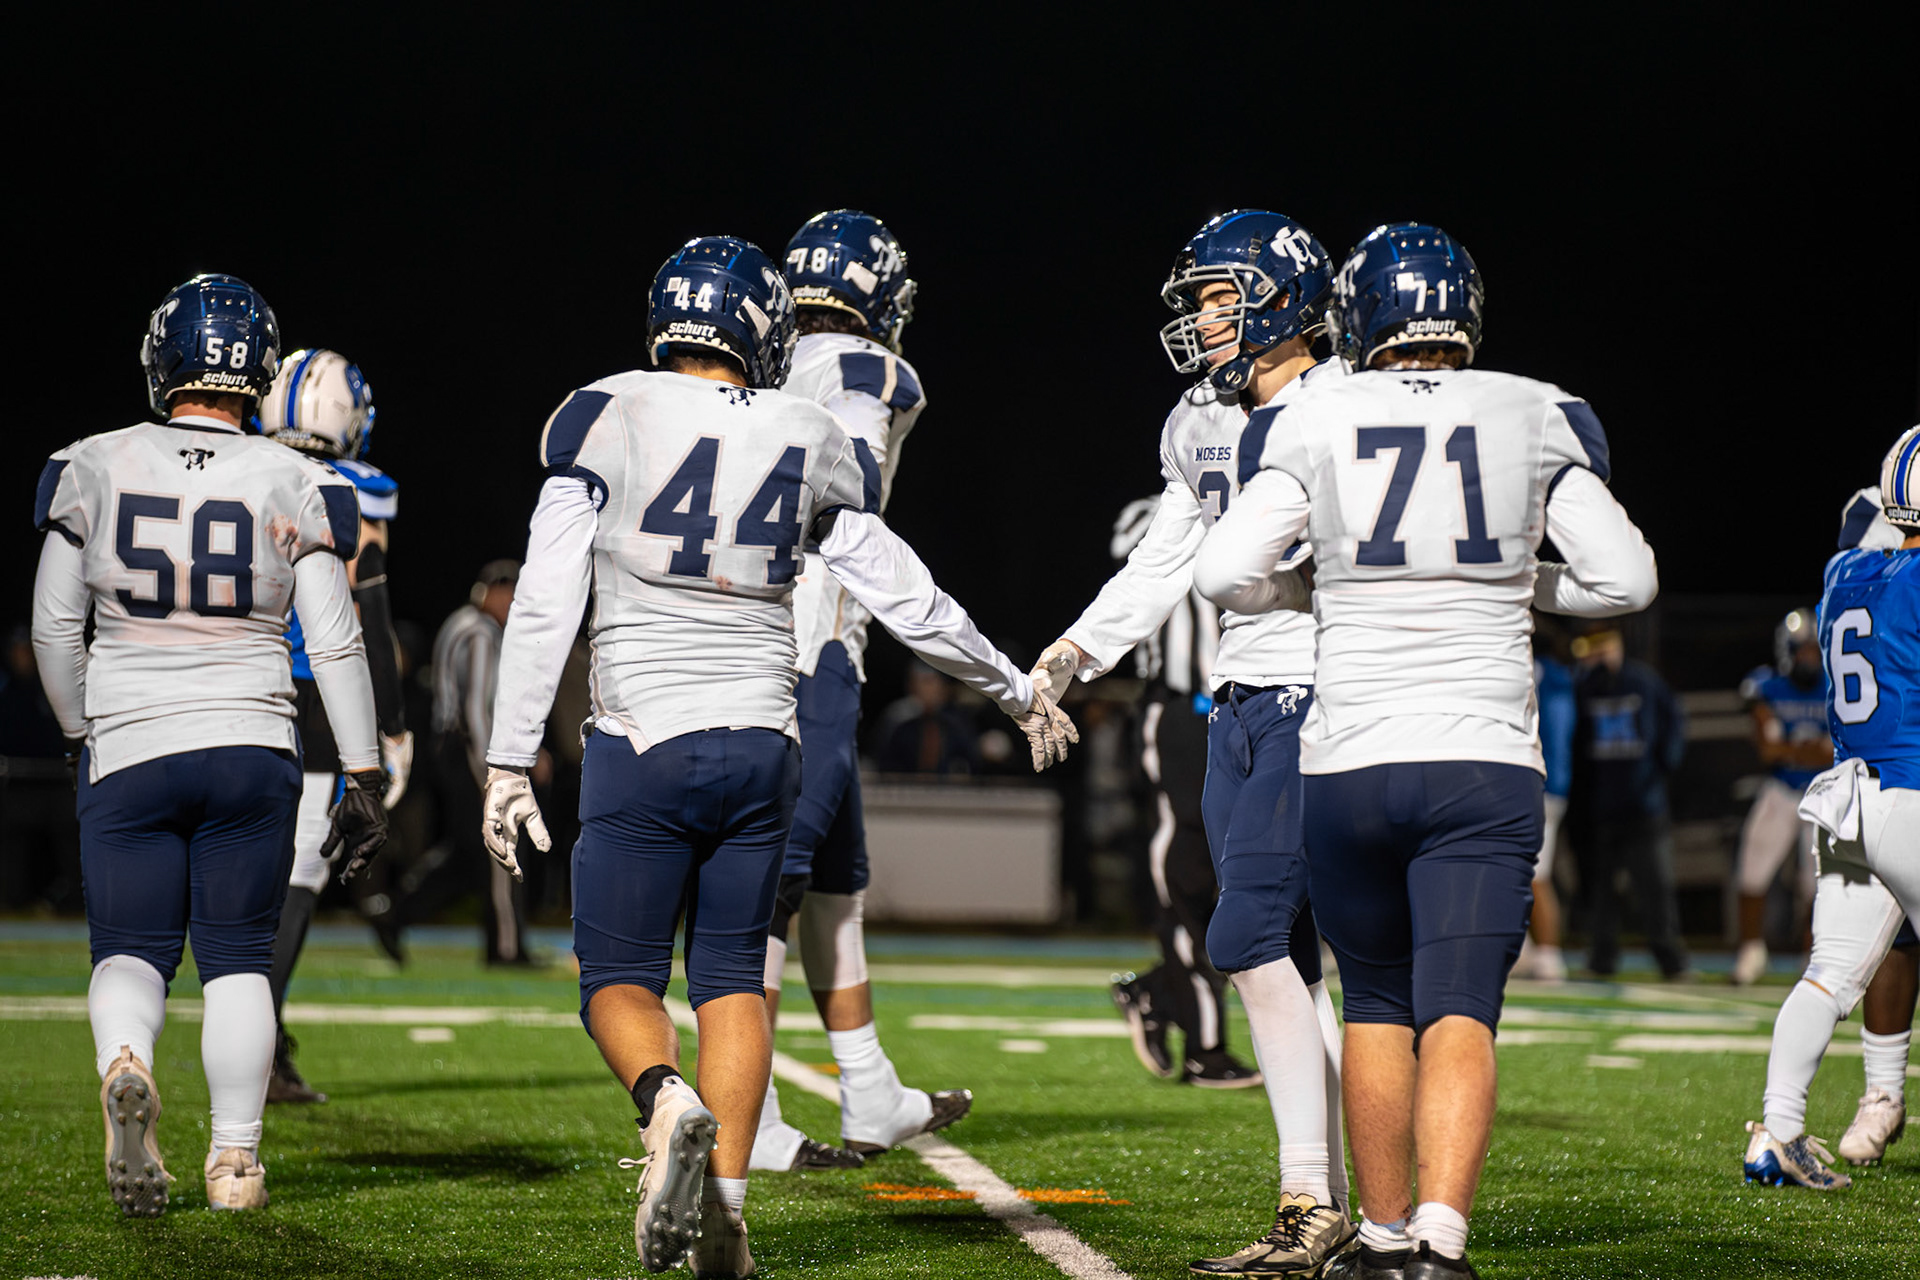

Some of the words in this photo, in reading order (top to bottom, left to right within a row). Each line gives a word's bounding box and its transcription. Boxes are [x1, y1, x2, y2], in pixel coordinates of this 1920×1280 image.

[792, 247, 829, 274] 78
[674, 279, 712, 313] 44
[1410, 279, 1448, 313] 71
[667, 319, 717, 338] schutt
[1406, 317, 1457, 334] schutt
[204, 336, 249, 370] 58
[201, 370, 249, 387] schutt
[1194, 446, 1232, 462] MOSES
[634, 433, 810, 586] 44
[1354, 425, 1503, 566] 71
[112, 490, 257, 619] 58
[1829, 607, 1879, 725] 6
